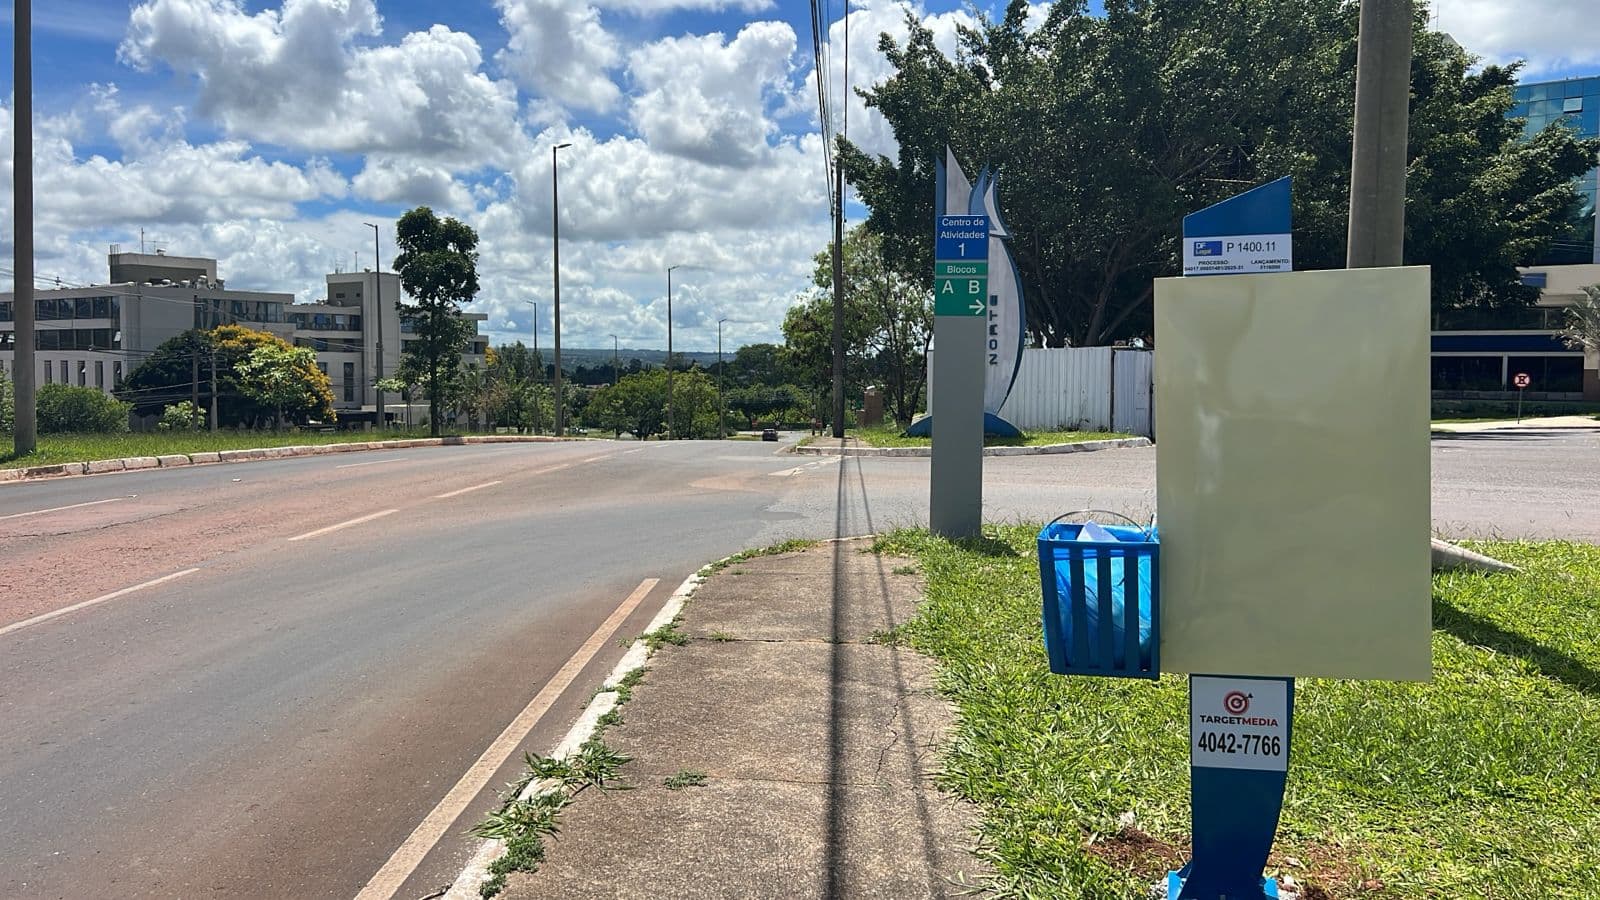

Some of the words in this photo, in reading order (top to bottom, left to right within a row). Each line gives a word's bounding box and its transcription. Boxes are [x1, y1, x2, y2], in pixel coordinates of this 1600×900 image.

[942, 217, 971, 226] Centro
[973, 217, 984, 226] de
[940, 230, 985, 239] Atividades
[958, 243, 965, 256] 1
[1227, 242, 1235, 252] P
[1238, 241, 1276, 252] 1400.11
[947, 265, 977, 274] Blocos
[942, 280, 954, 294] A
[969, 280, 980, 294] B
[989, 294, 998, 366] NORTE
[1200, 715, 1279, 727] TARGETMEDIA
[1198, 731, 1281, 756] 4042-7766
